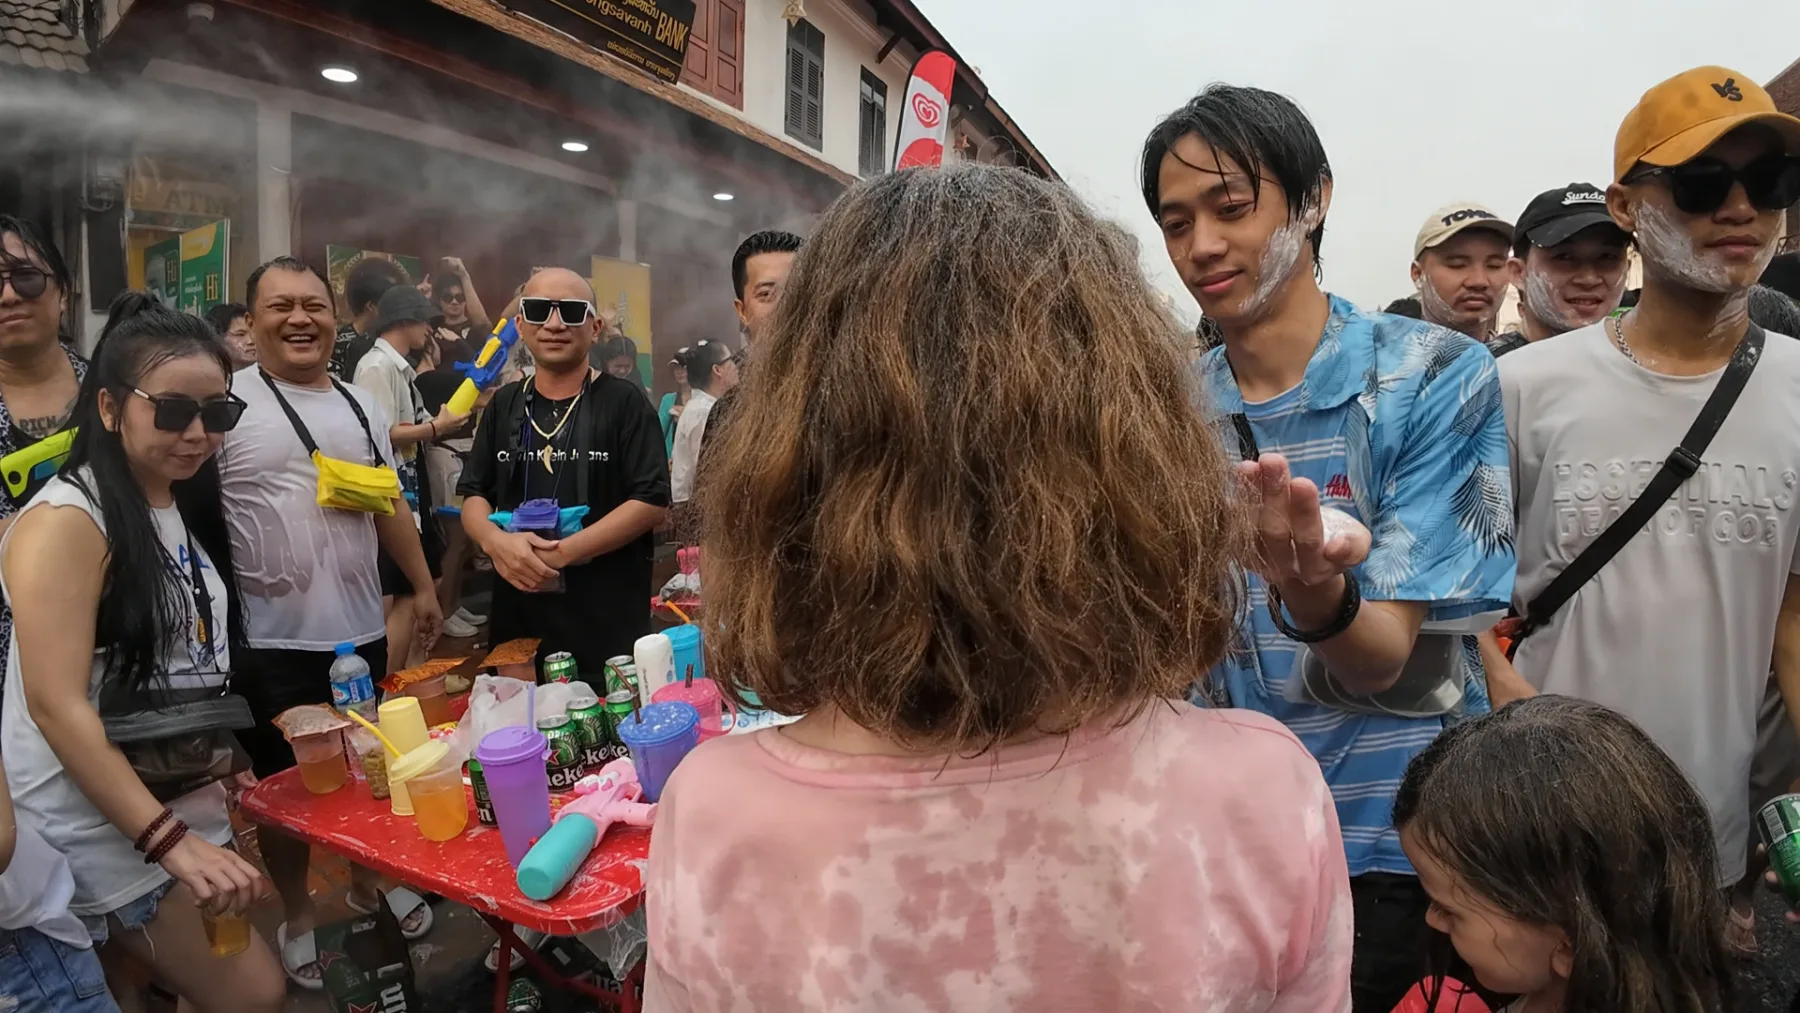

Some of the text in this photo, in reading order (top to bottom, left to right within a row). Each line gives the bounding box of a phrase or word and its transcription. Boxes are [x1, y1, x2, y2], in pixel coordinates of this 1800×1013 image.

[655, 12, 689, 52] BANK
[1711, 78, 1743, 101] VS
[206, 272, 219, 301] Hi
[1659, 505, 1707, 537] OF
